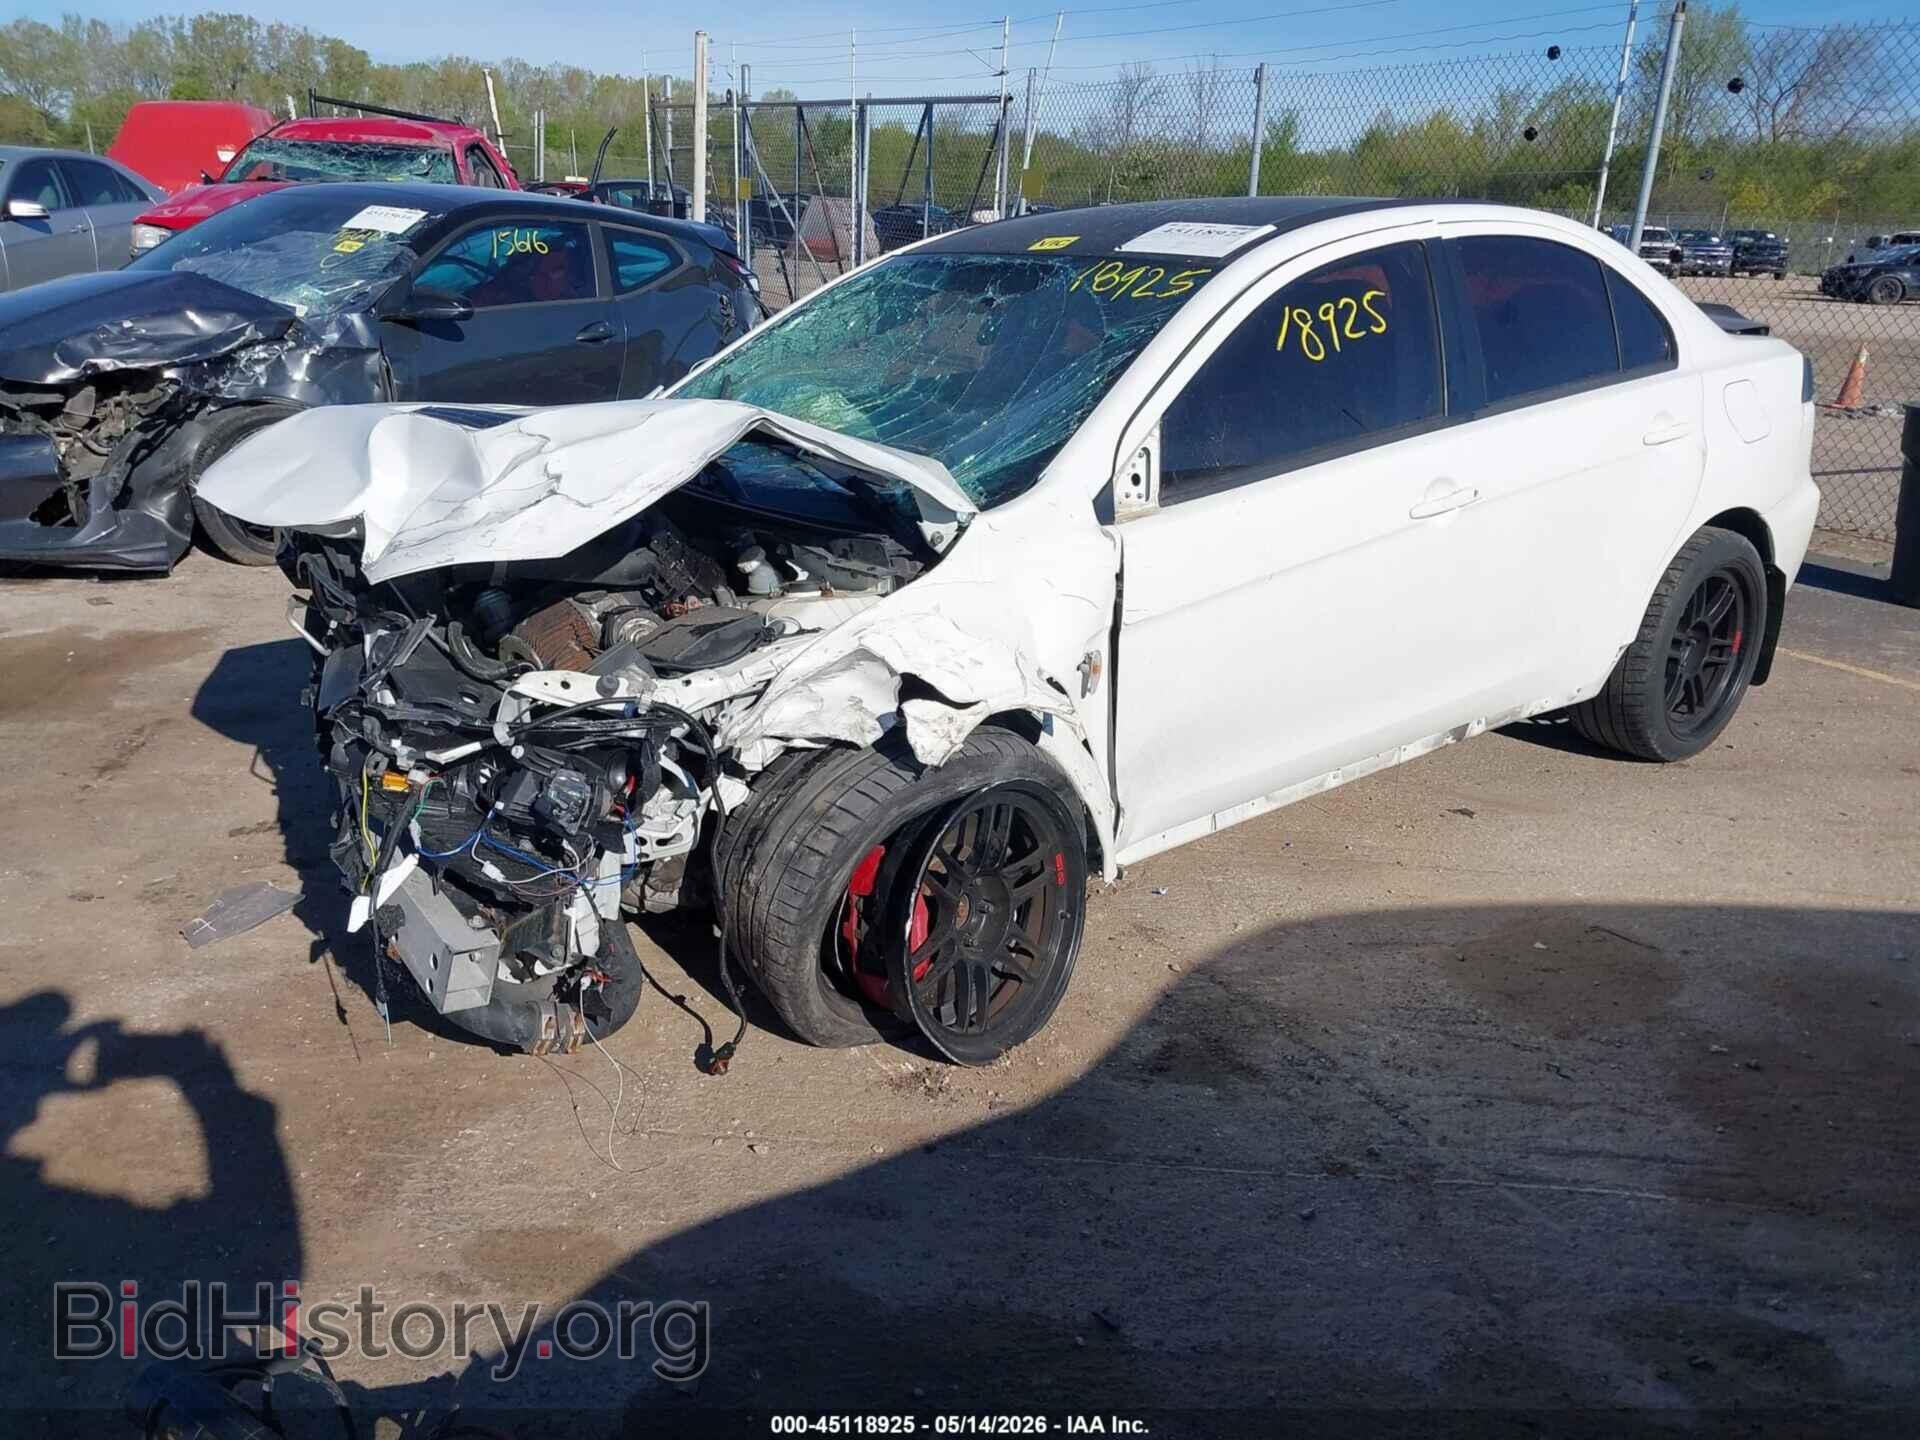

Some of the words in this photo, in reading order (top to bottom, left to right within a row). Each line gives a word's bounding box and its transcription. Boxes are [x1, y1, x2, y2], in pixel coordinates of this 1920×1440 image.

[492, 228, 549, 258] 15616
[1069, 259, 1212, 301] 18925
[1276, 290, 1387, 361] 18925
